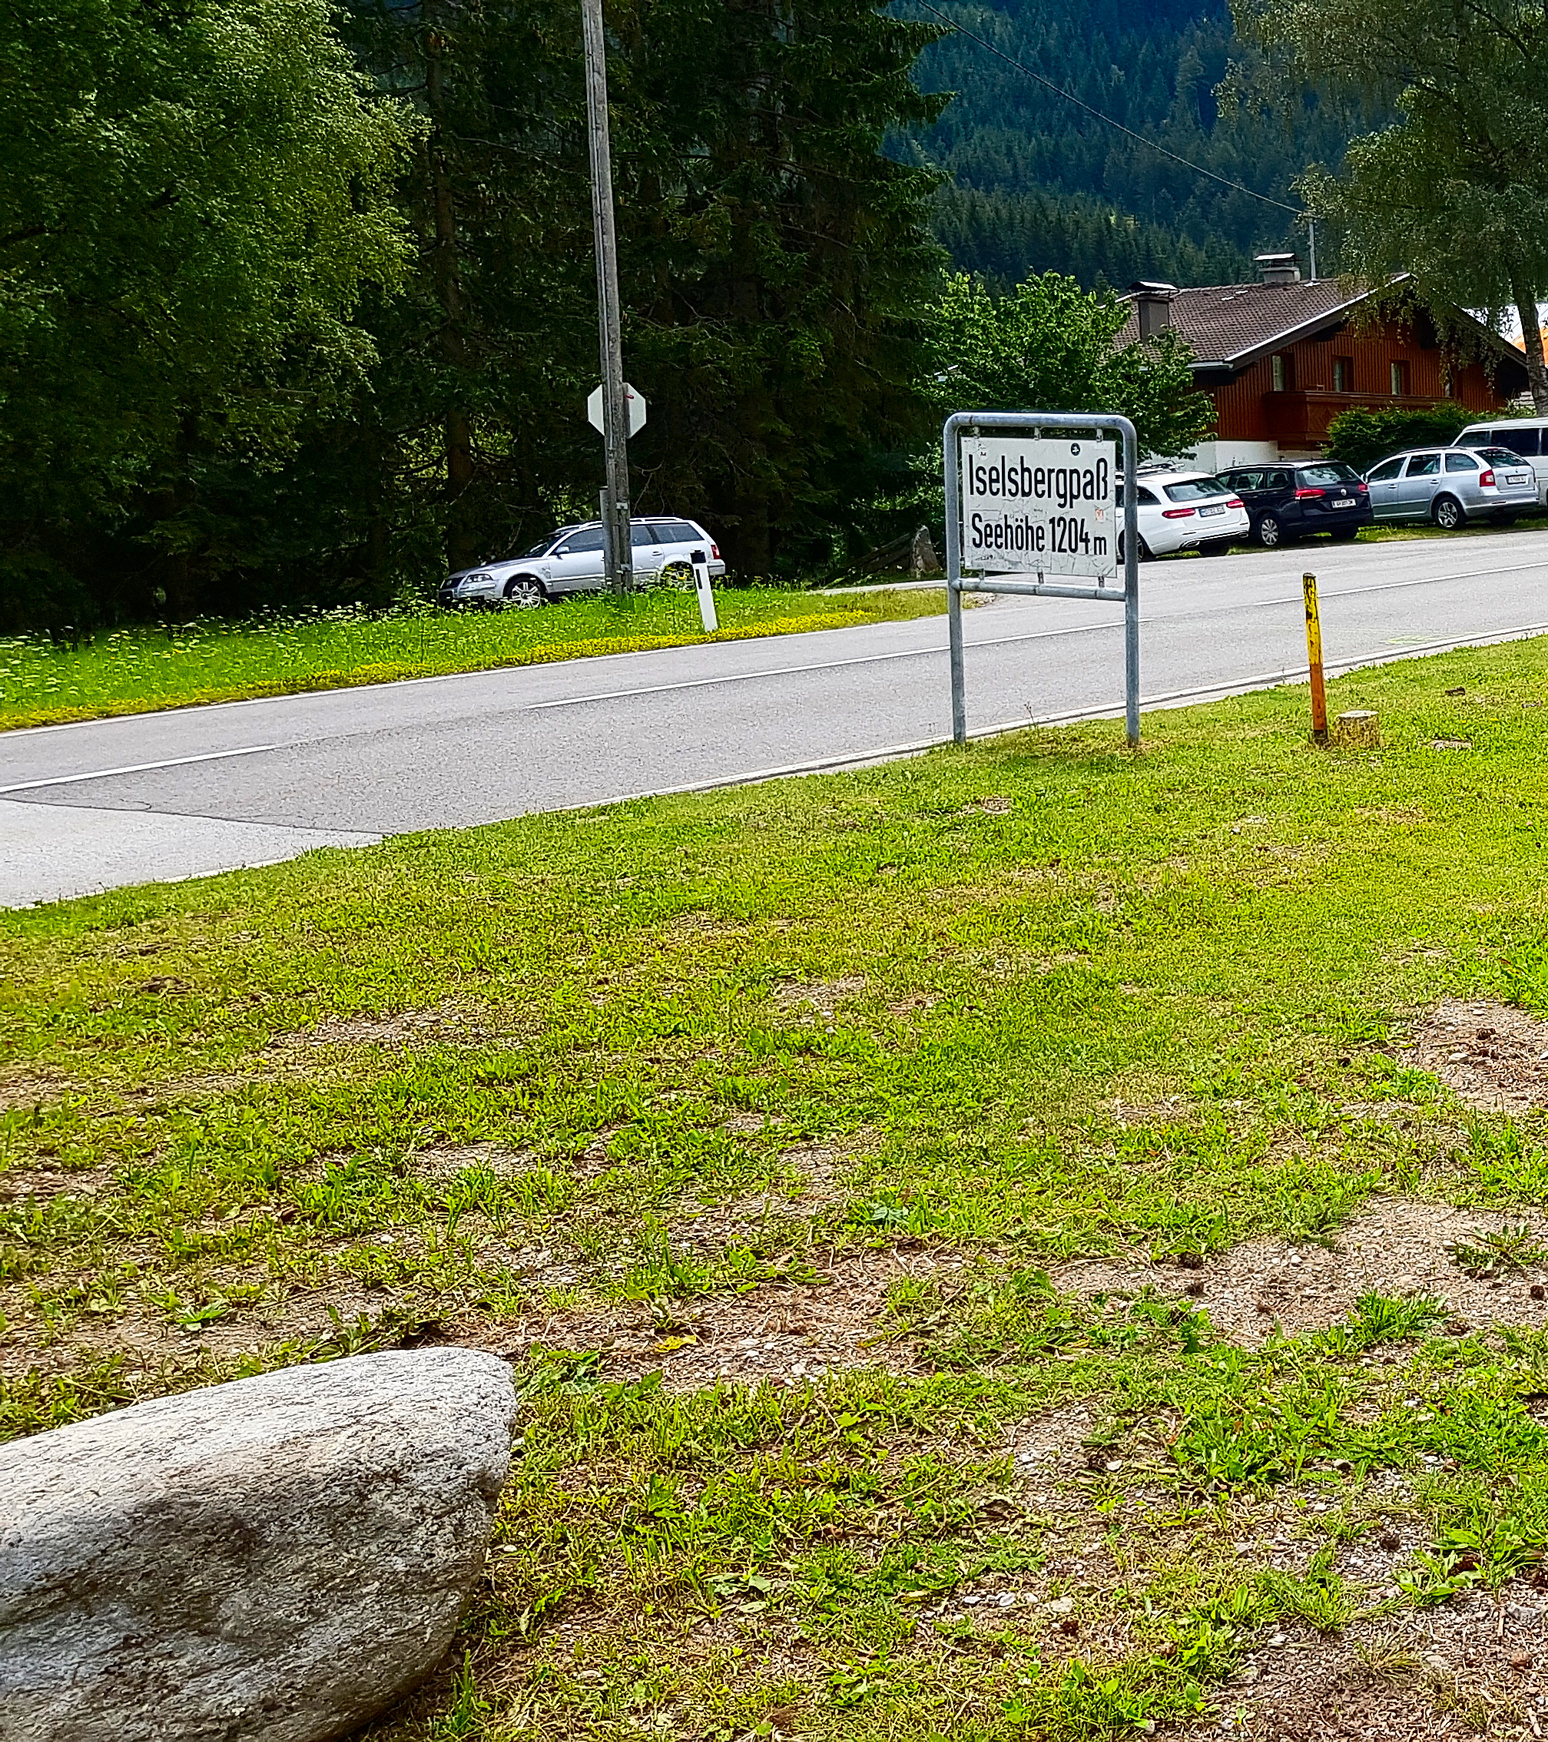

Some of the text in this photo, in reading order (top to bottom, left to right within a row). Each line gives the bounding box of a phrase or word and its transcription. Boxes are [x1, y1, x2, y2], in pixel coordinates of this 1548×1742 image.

[968, 453, 1108, 509] Iselsbergpaß
[971, 513, 1107, 555] Seehöhe 1204 m
